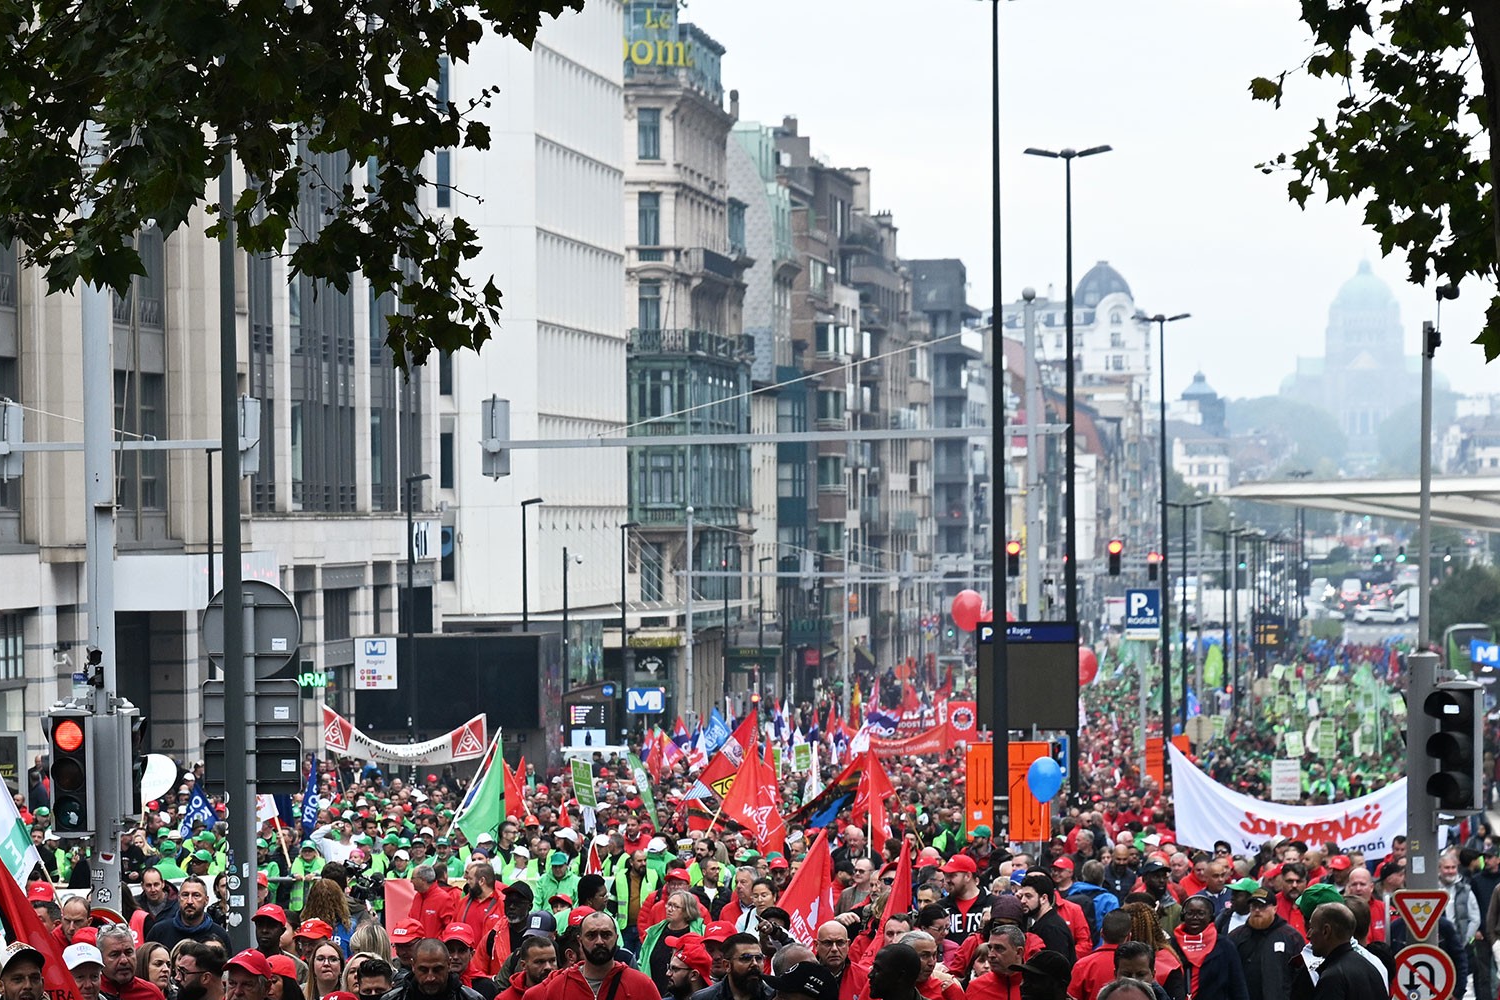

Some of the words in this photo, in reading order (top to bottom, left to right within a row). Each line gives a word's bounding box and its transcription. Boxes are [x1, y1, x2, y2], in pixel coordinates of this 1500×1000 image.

[644, 8, 671, 29] Le
[1131, 593, 1148, 616] P
[1127, 617, 1157, 625] ROGIER
[1013, 626, 1031, 635] Rogier
[162, 738, 174, 748] 20
[354, 734, 372, 749] Wir
